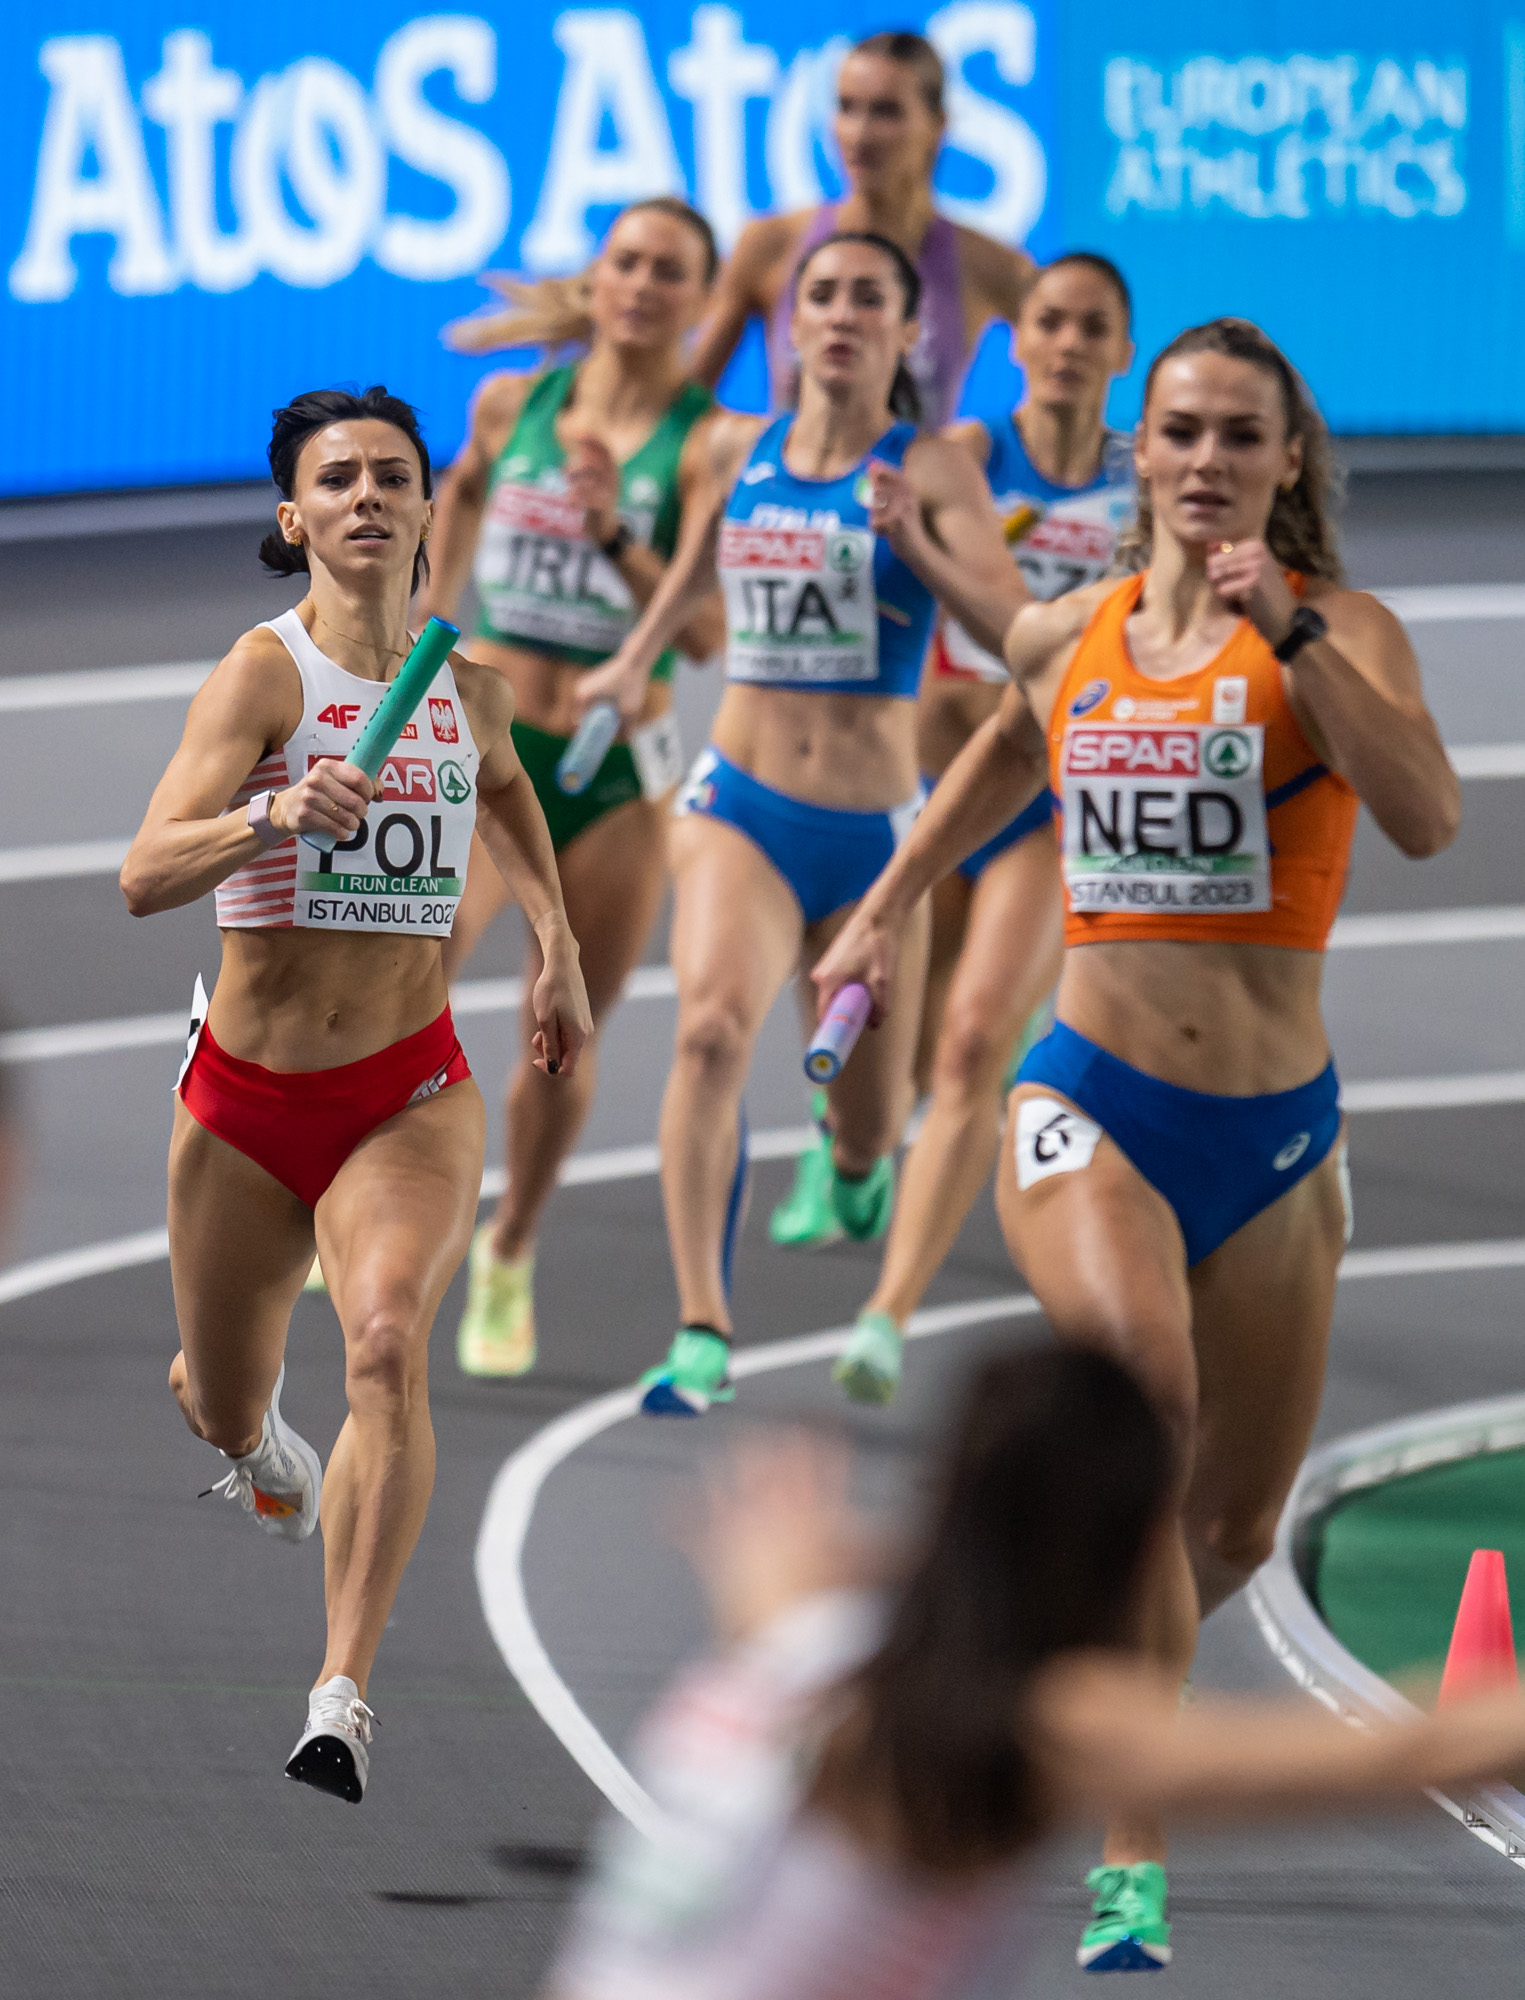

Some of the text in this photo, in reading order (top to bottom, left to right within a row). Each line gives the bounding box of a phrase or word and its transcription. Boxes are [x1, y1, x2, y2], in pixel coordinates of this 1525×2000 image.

[1103, 54, 1467, 138] EUROPEAN
[1104, 135, 1467, 219] ATHLETICS
[507, 535, 614, 604] IRL
[741, 577, 840, 637] ITA
[317, 703, 361, 729] 4F
[1069, 733, 1198, 772] SPAR
[379, 763, 434, 795] AR
[318, 813, 456, 878] POL
[1077, 789, 1244, 856] NED
[339, 875, 440, 893] I RUN CLEAN
[1071, 881, 1255, 906] STANBUL 2023
[308, 898, 456, 924] ISTANBUL 202
[1034, 1113, 1069, 1163] 6
